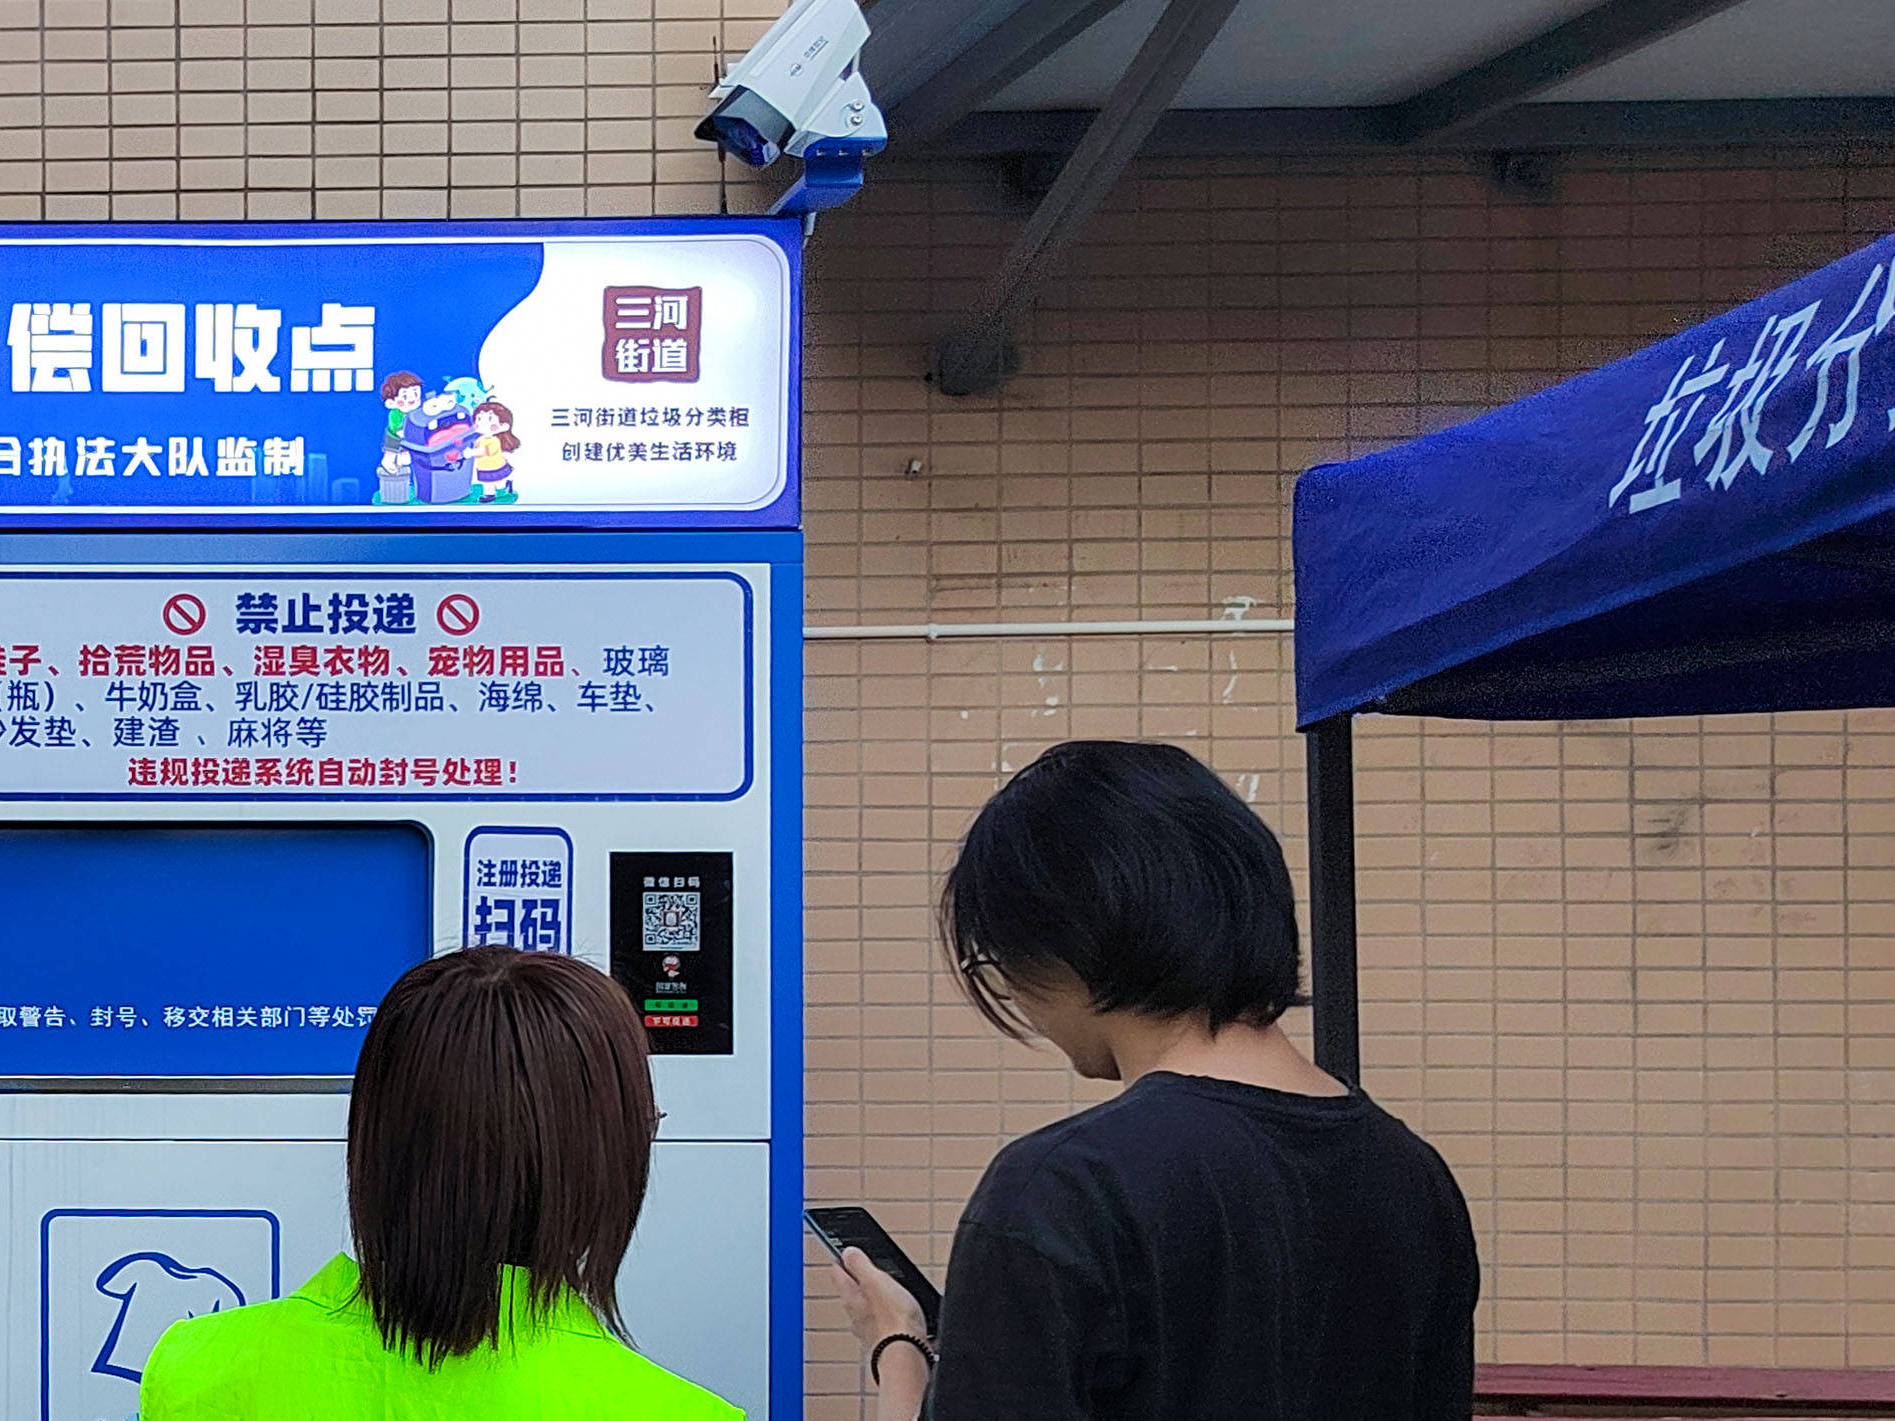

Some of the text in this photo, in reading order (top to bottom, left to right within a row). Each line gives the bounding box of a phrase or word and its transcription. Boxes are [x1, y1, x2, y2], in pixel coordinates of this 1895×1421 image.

[615, 295, 688, 330] 三河
[615, 338, 688, 373] 街道
[1609, 256, 1895, 514] 垃圾分
[562, 441, 738, 462] 创建优美生活环境
[235, 592, 417, 635] 禁止投递
[476, 859, 563, 889] 注册投递
[474, 895, 561, 952] 扫码
